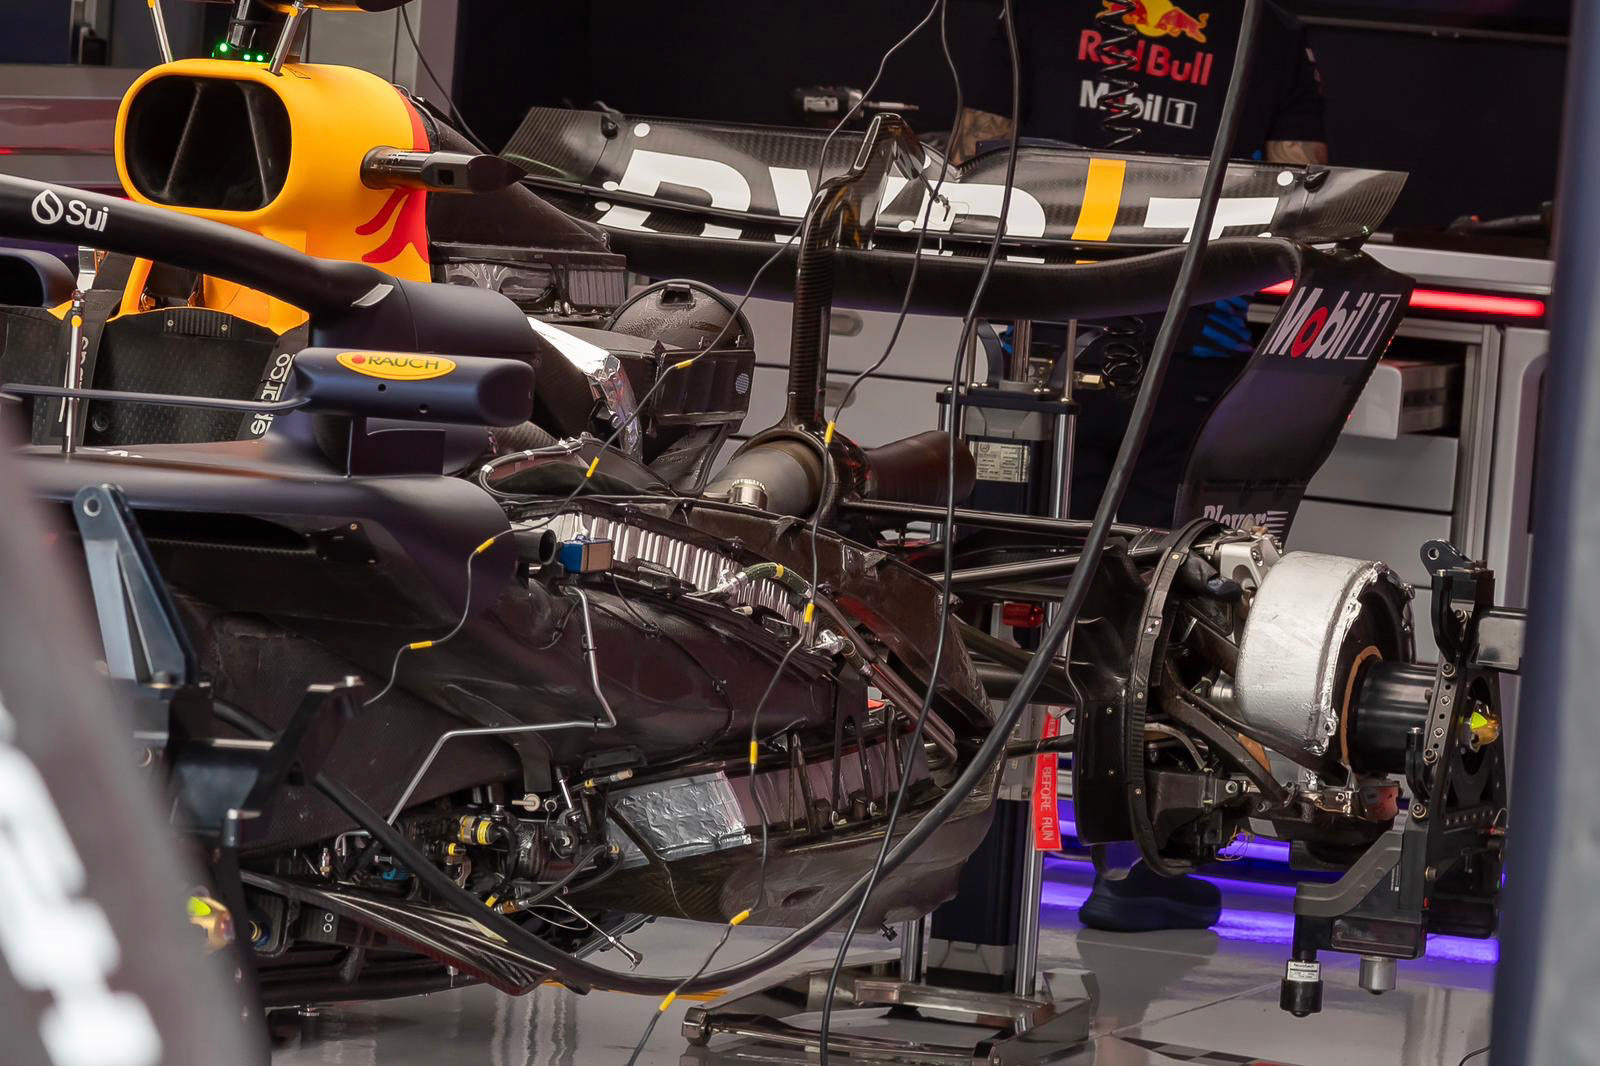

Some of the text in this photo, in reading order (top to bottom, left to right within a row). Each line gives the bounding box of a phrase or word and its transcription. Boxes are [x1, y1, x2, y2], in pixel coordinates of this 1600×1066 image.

[1078, 29, 1213, 86] Red Bull
[65, 200, 109, 232] Sui
[1261, 286, 1394, 360] Mobil 1
[368, 356, 439, 370] RAUCH
[1040, 766, 1053, 812] BEFORE
[1042, 816, 1056, 841] RUN
